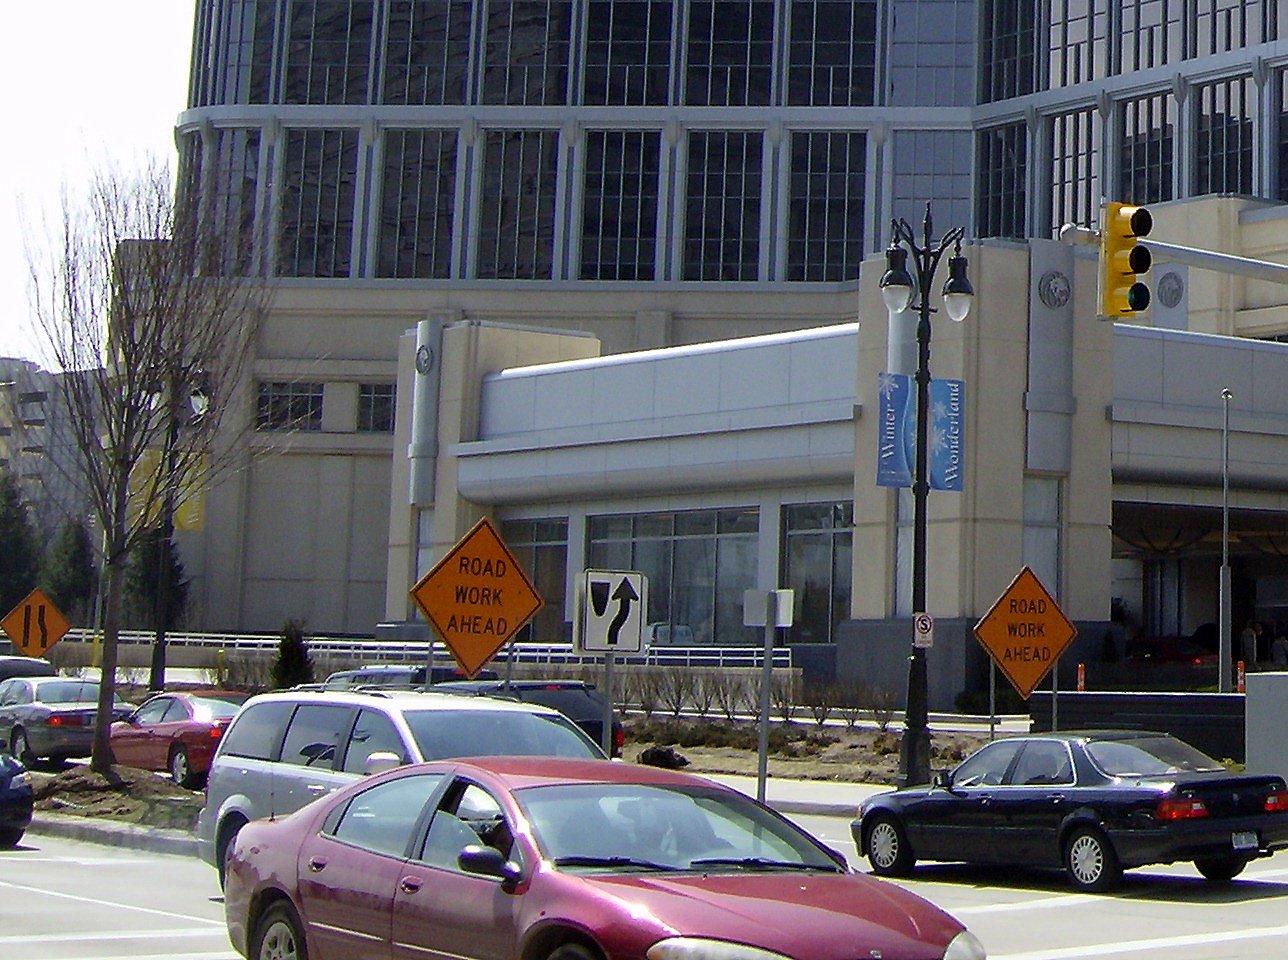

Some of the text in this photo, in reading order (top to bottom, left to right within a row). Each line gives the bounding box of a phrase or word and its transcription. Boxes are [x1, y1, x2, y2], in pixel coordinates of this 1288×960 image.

[880, 406, 896, 466] Winter
[944, 382, 960, 489] Wonderland
[458, 556, 507, 578] ROAD
[455, 586, 503, 606] WORK
[1009, 599, 1047, 615] ROAD
[447, 614, 508, 636] AHEAD
[1007, 622, 1045, 638] WORK
[1004, 646, 1051, 662] AHEAD
